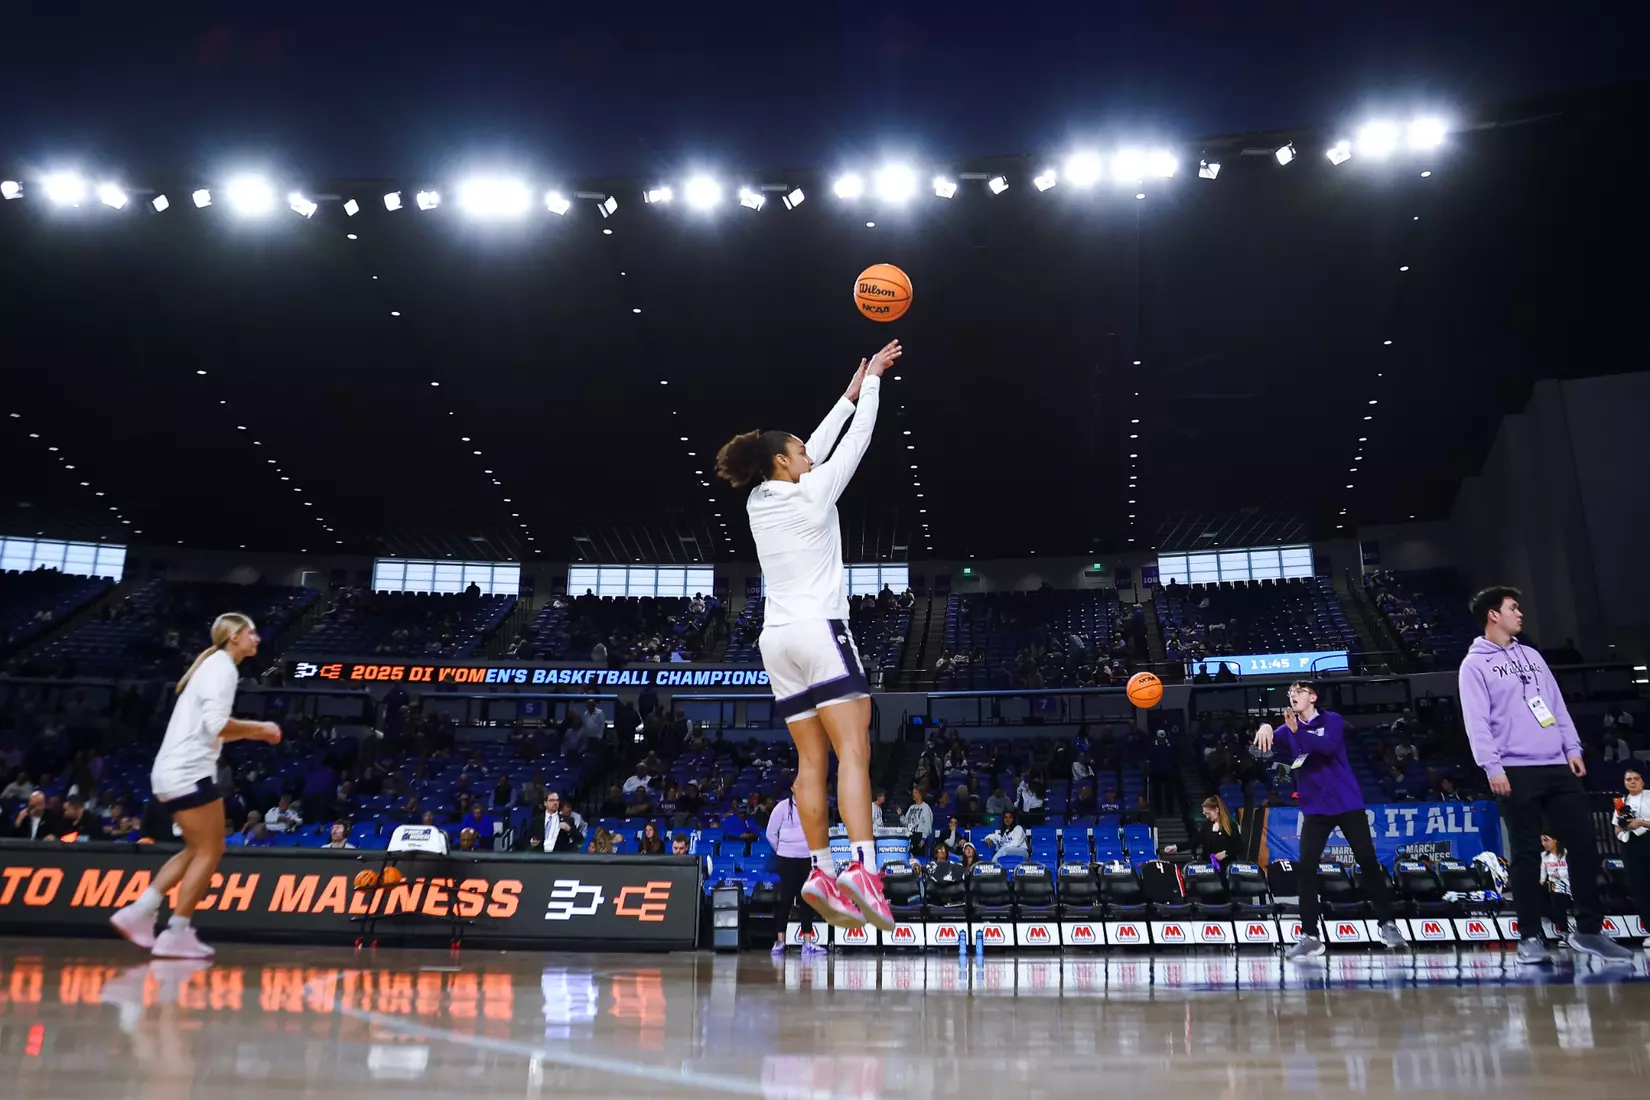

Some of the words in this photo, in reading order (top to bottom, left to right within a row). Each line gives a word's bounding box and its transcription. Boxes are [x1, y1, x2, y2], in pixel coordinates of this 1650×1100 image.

[859, 283, 895, 297] Wilson
[862, 303, 890, 313] NCAA
[1250, 658, 1290, 670] 11:45
[350, 665, 404, 681] 2025
[438, 667, 528, 684] WOMEN'S
[532, 669, 650, 685] BASKETBALL
[655, 670, 769, 685] CHAMPIONS
[525, 703, 534, 714] 5
[1037, 698, 1048, 710] 7
[1385, 808, 1419, 837] IT
[1426, 806, 1479, 834] ALL
[1406, 844, 1436, 854] MARCH
[1156, 862, 1164, 874] 4
[1280, 860, 1293, 872] 15
[0, 866, 64, 906] TO
[70, 868, 260, 912] MACH
